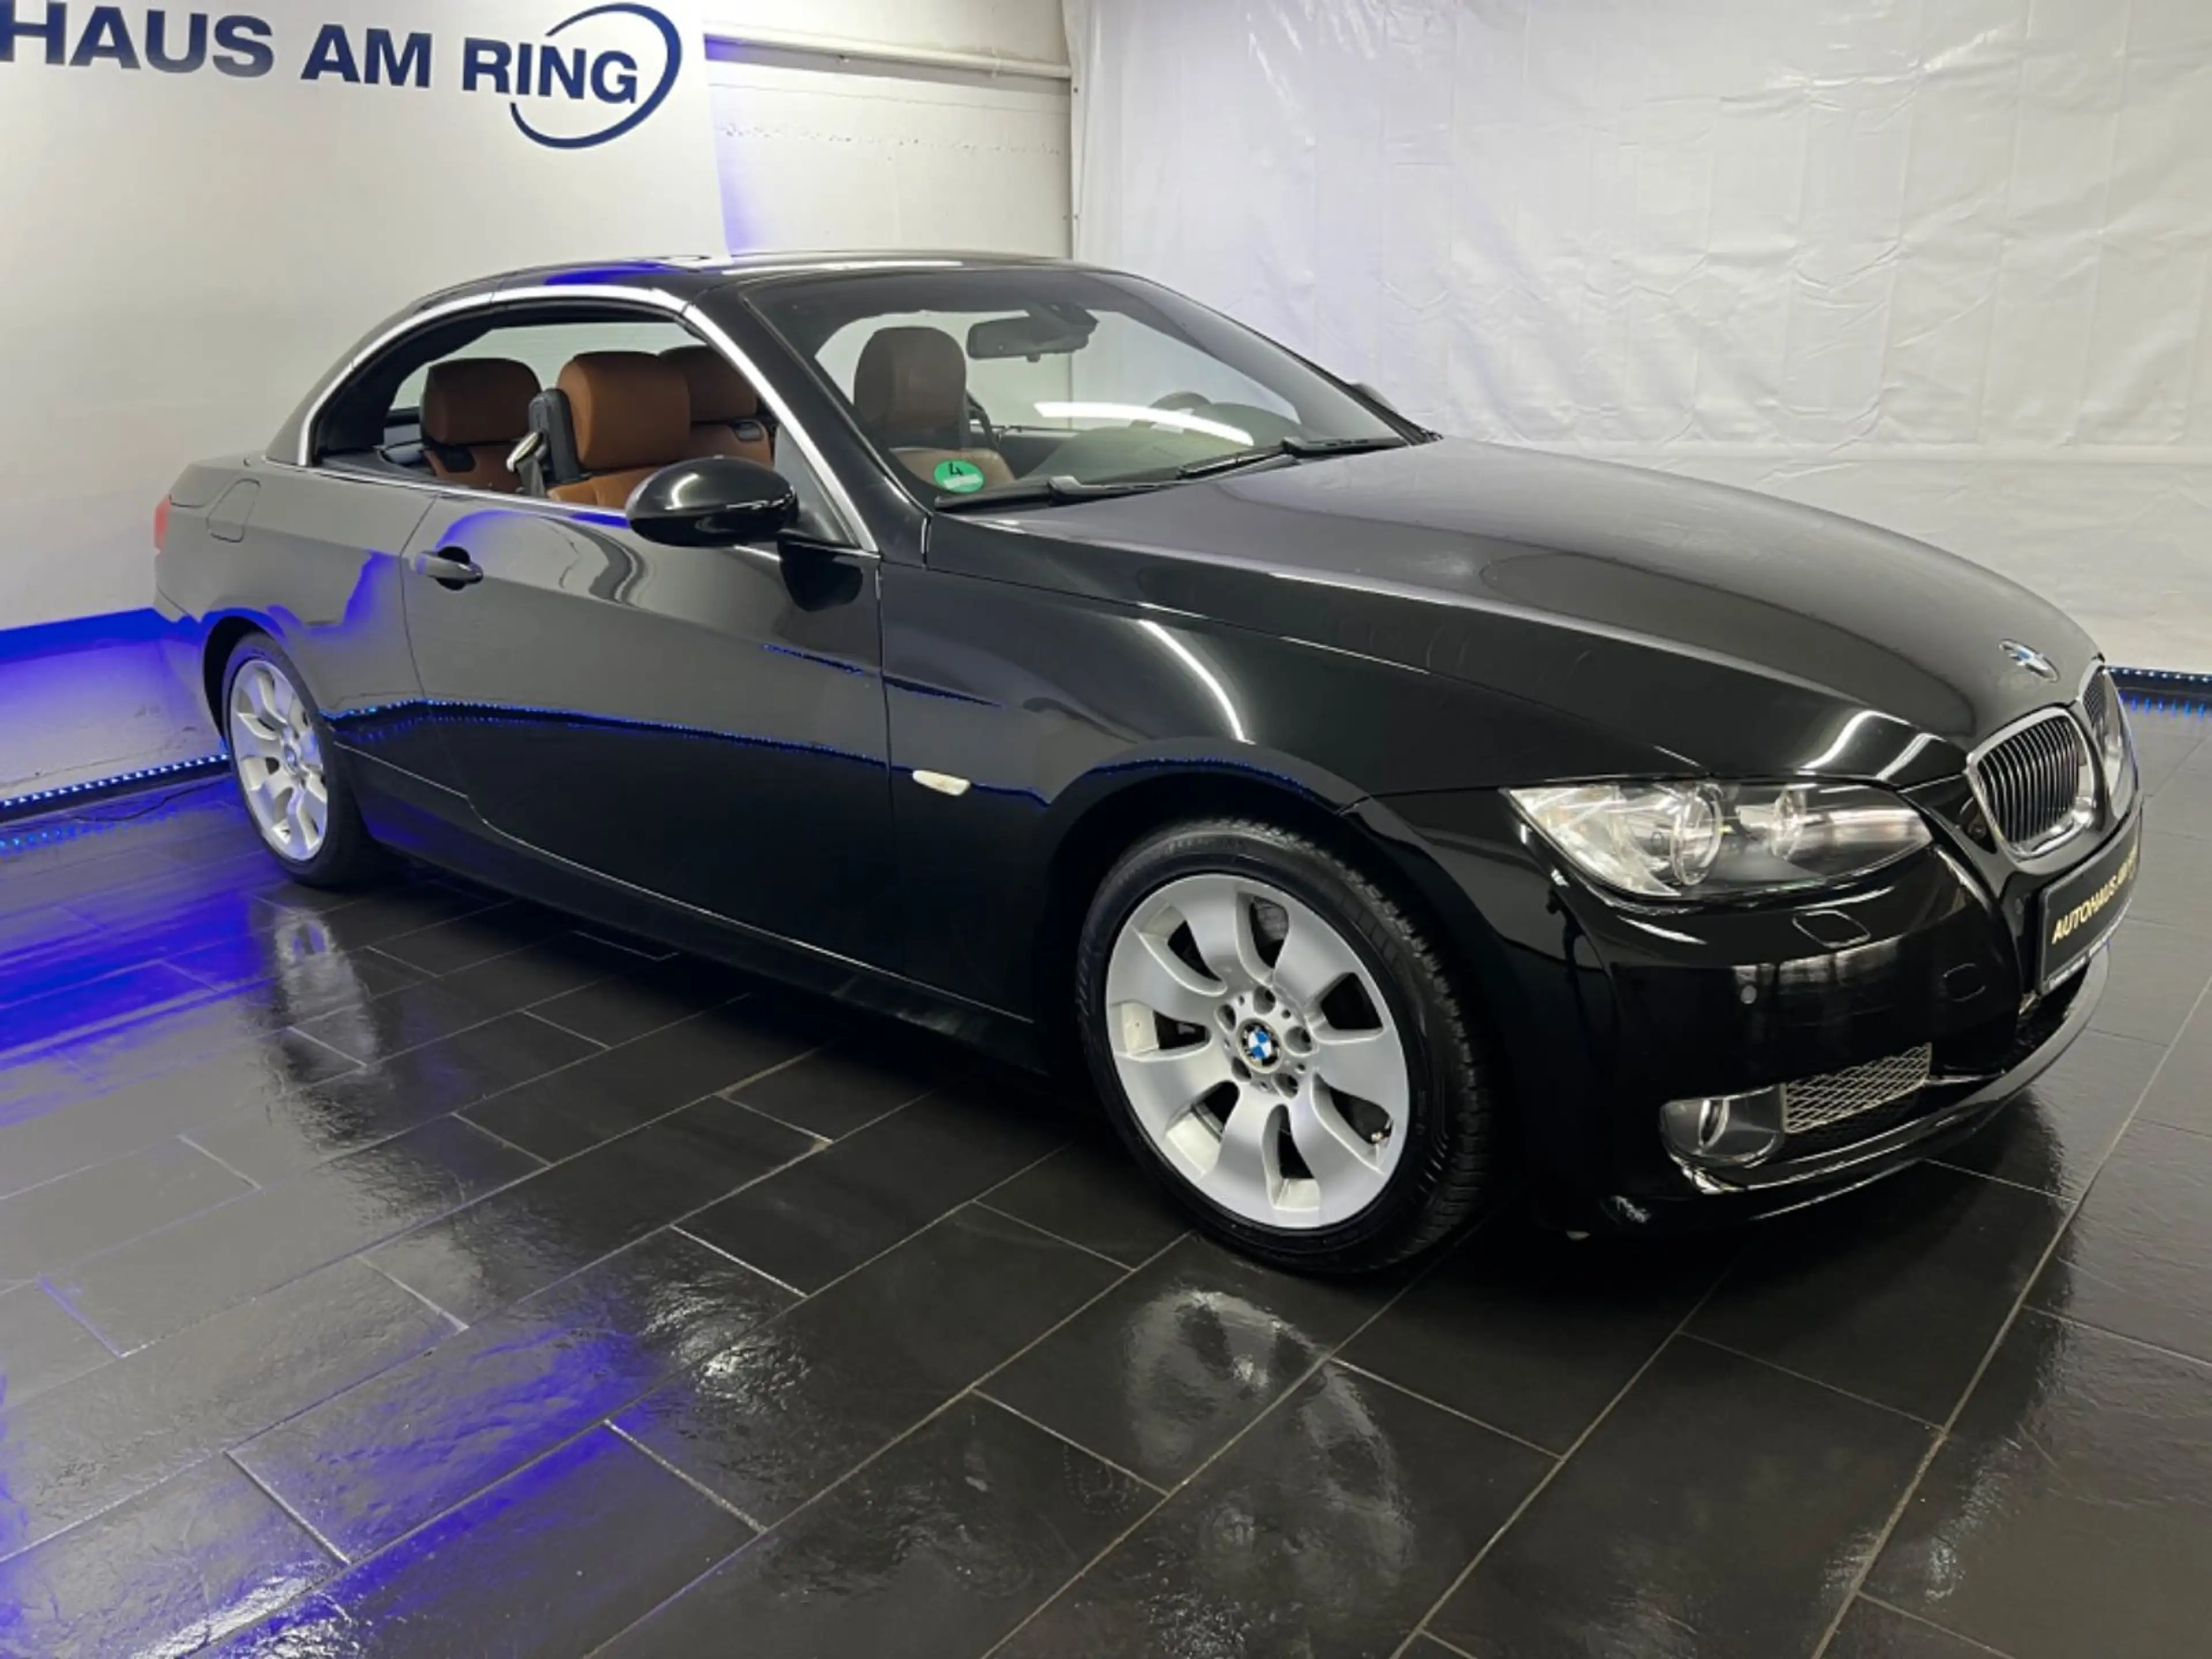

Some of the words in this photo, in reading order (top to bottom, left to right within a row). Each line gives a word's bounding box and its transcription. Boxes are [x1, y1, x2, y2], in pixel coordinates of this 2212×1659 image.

[0, 0, 274, 78] HAUS
[300, 24, 432, 88] AM
[462, 37, 638, 104] RING
[948, 461, 964, 476] 4
[2051, 874, 2119, 945] AUTOHAUS
